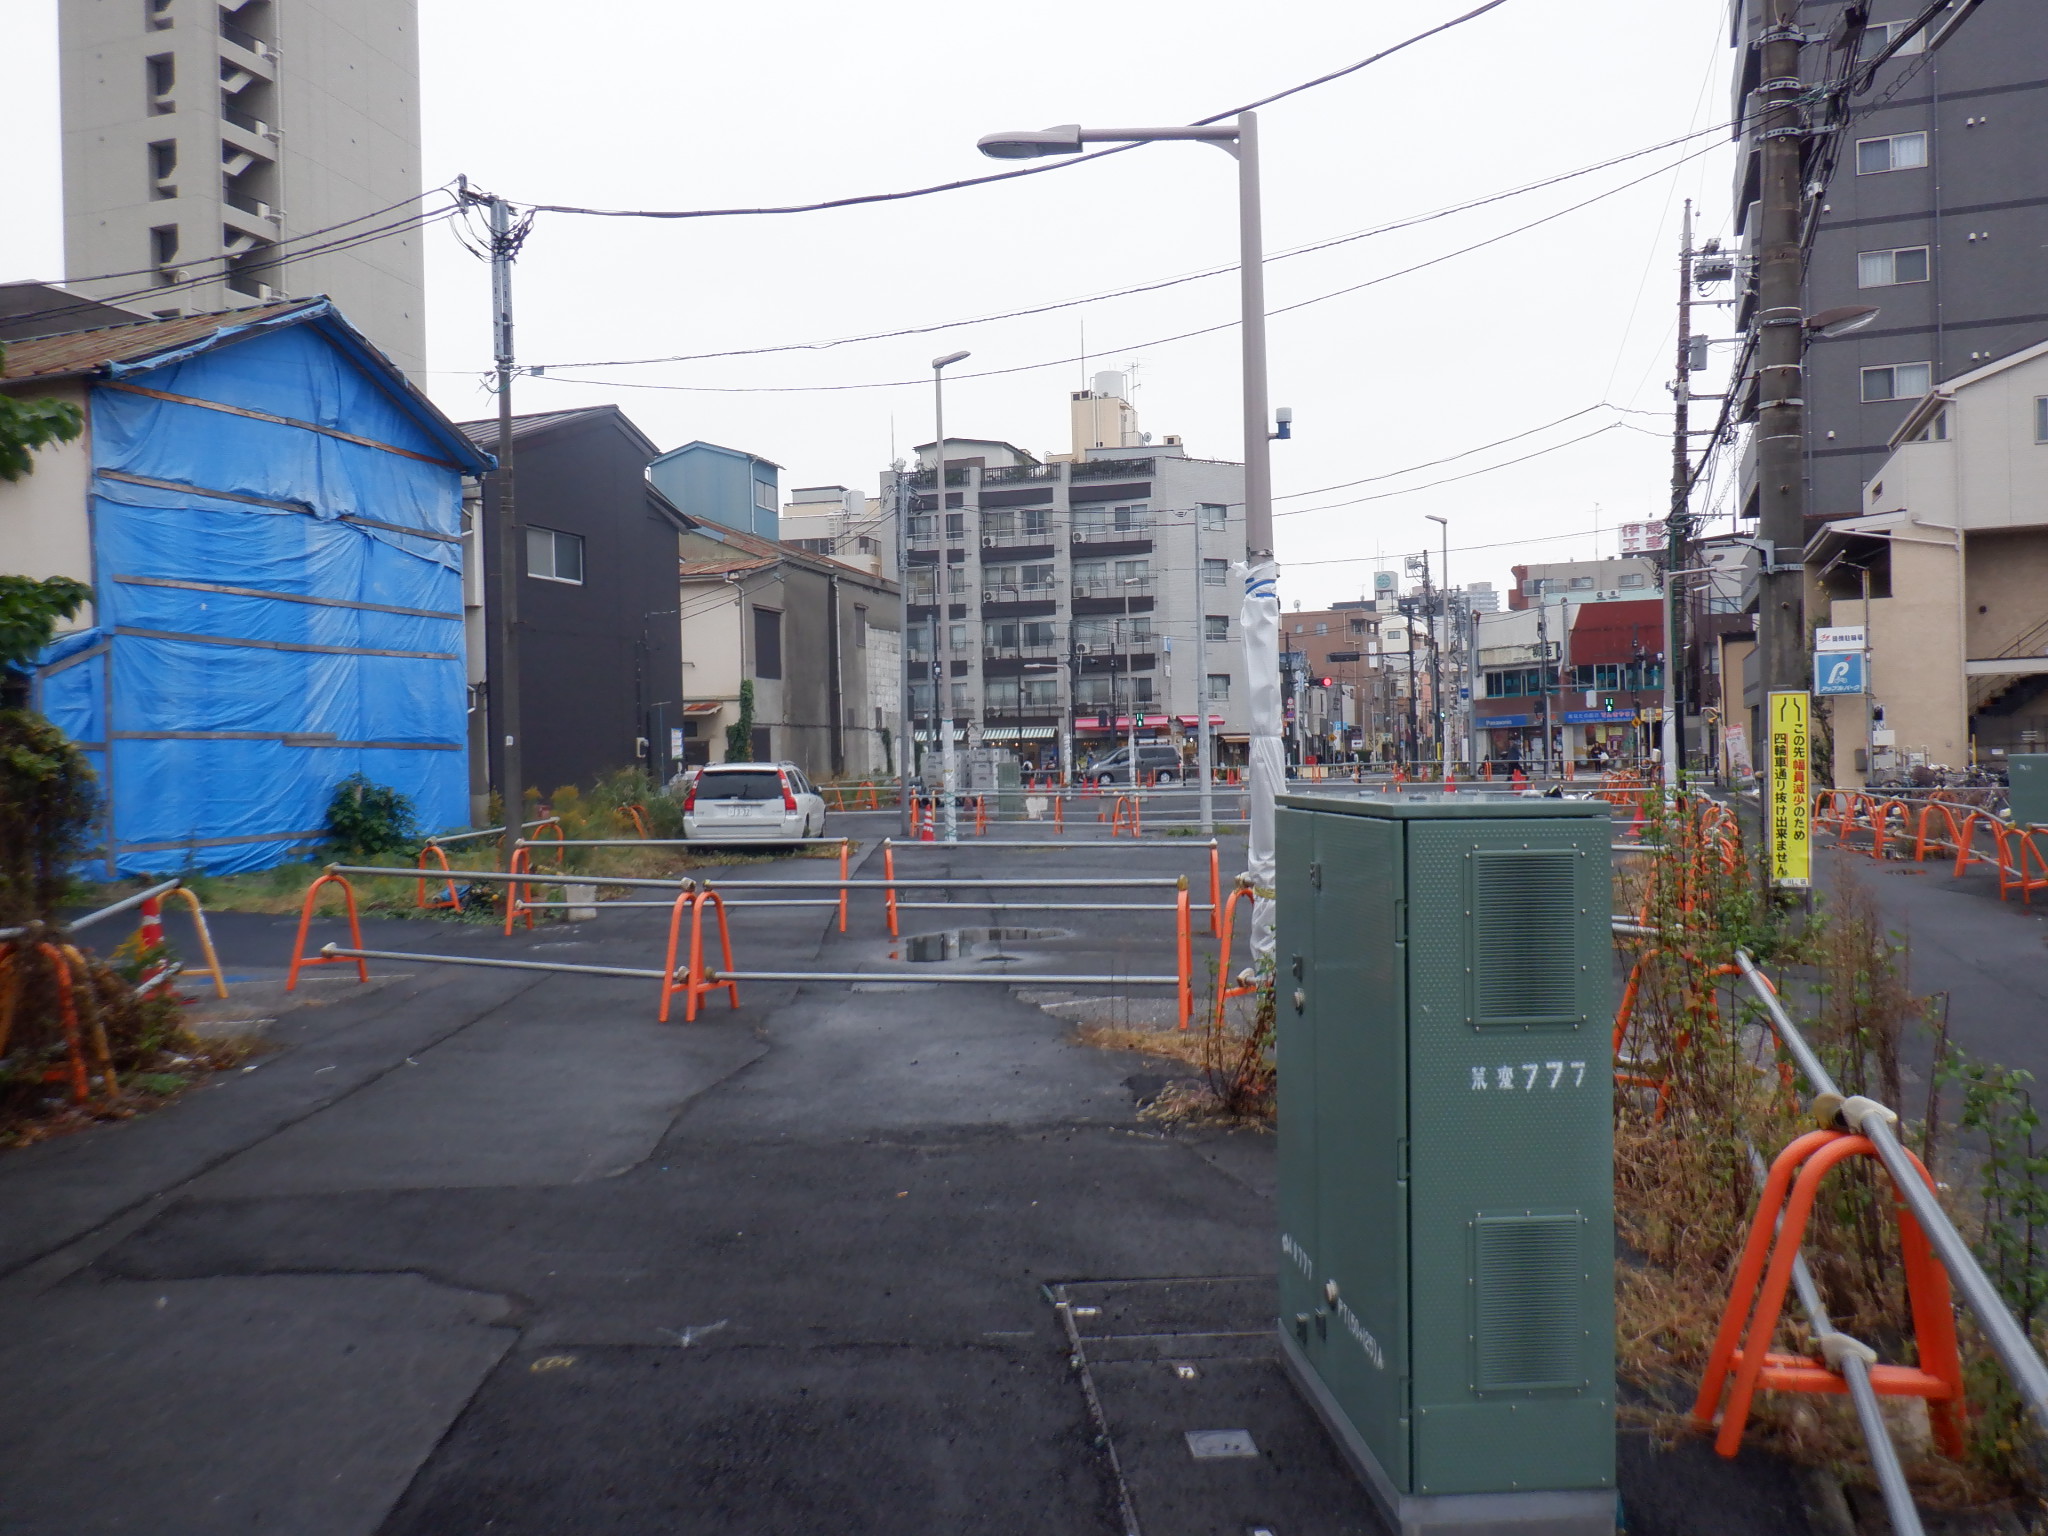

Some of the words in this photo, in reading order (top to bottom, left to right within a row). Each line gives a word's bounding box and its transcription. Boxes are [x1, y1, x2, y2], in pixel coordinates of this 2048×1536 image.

[1774, 732, 1788, 876] 四輪車通り抜け出来ません
[1792, 723, 1806, 841] この先幅員減少のため
